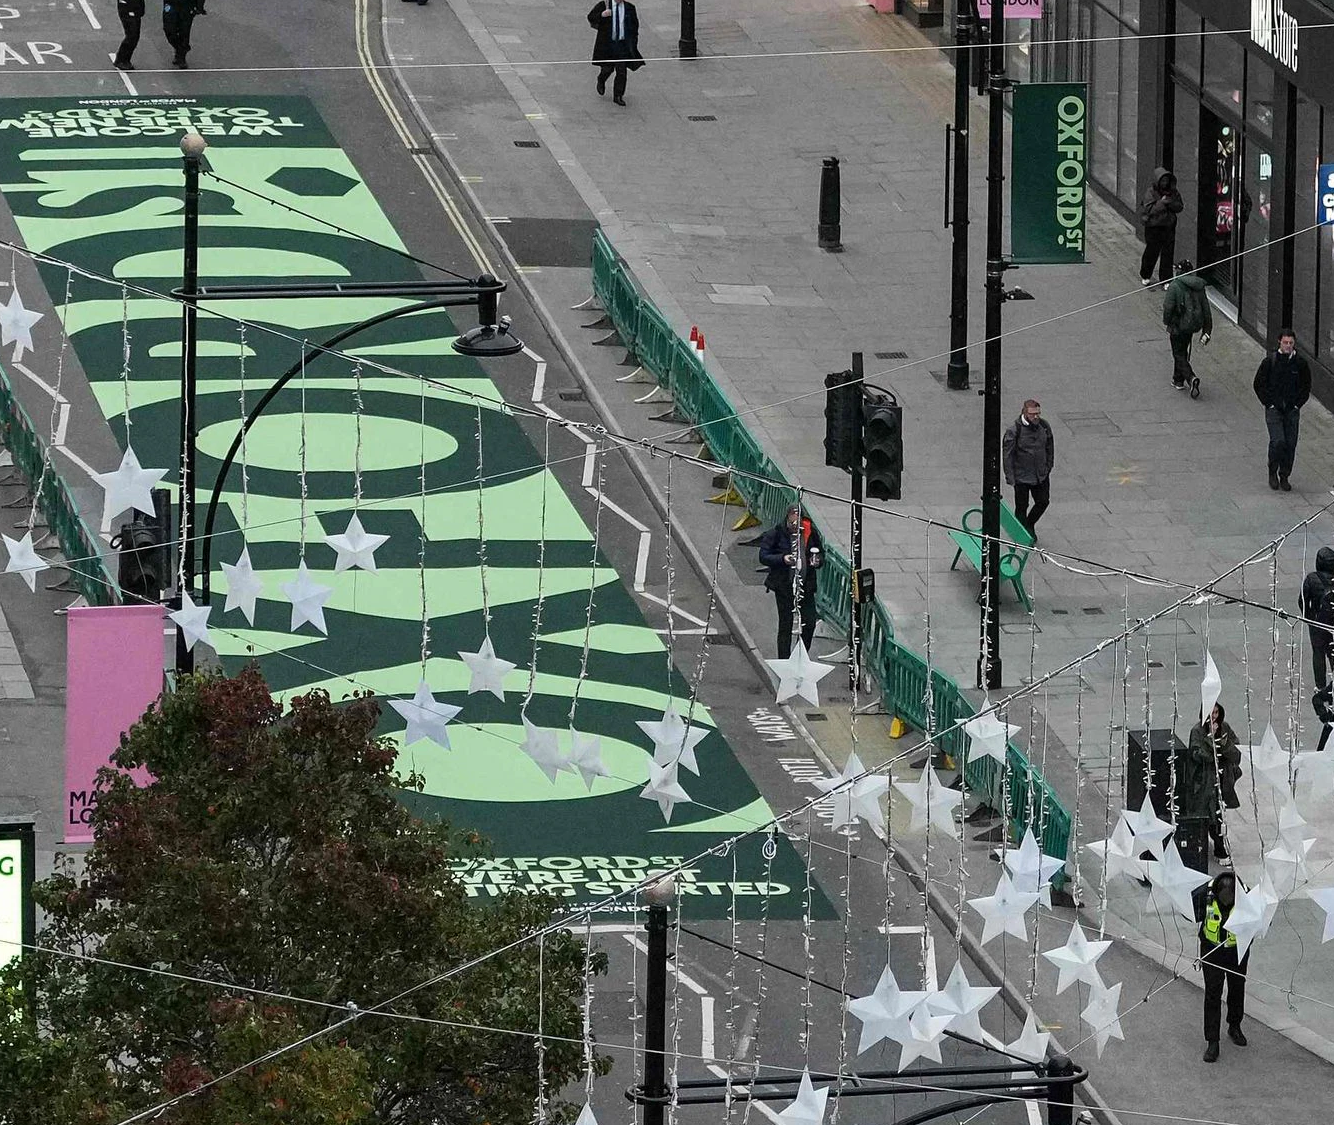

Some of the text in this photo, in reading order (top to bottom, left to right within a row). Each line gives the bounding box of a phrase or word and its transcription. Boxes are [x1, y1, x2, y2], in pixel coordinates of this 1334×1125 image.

[55, 107, 269, 119] OXFORD
[127, 116, 225, 127] THE
[230, 116, 305, 127] TO
[27, 125, 283, 139] WELCOME
[1056, 94, 1085, 252] OXFORD ST
[747, 713, 799, 742] WAYS
[649, 856, 685, 865] ST
[583, 881, 792, 898] STRTED
